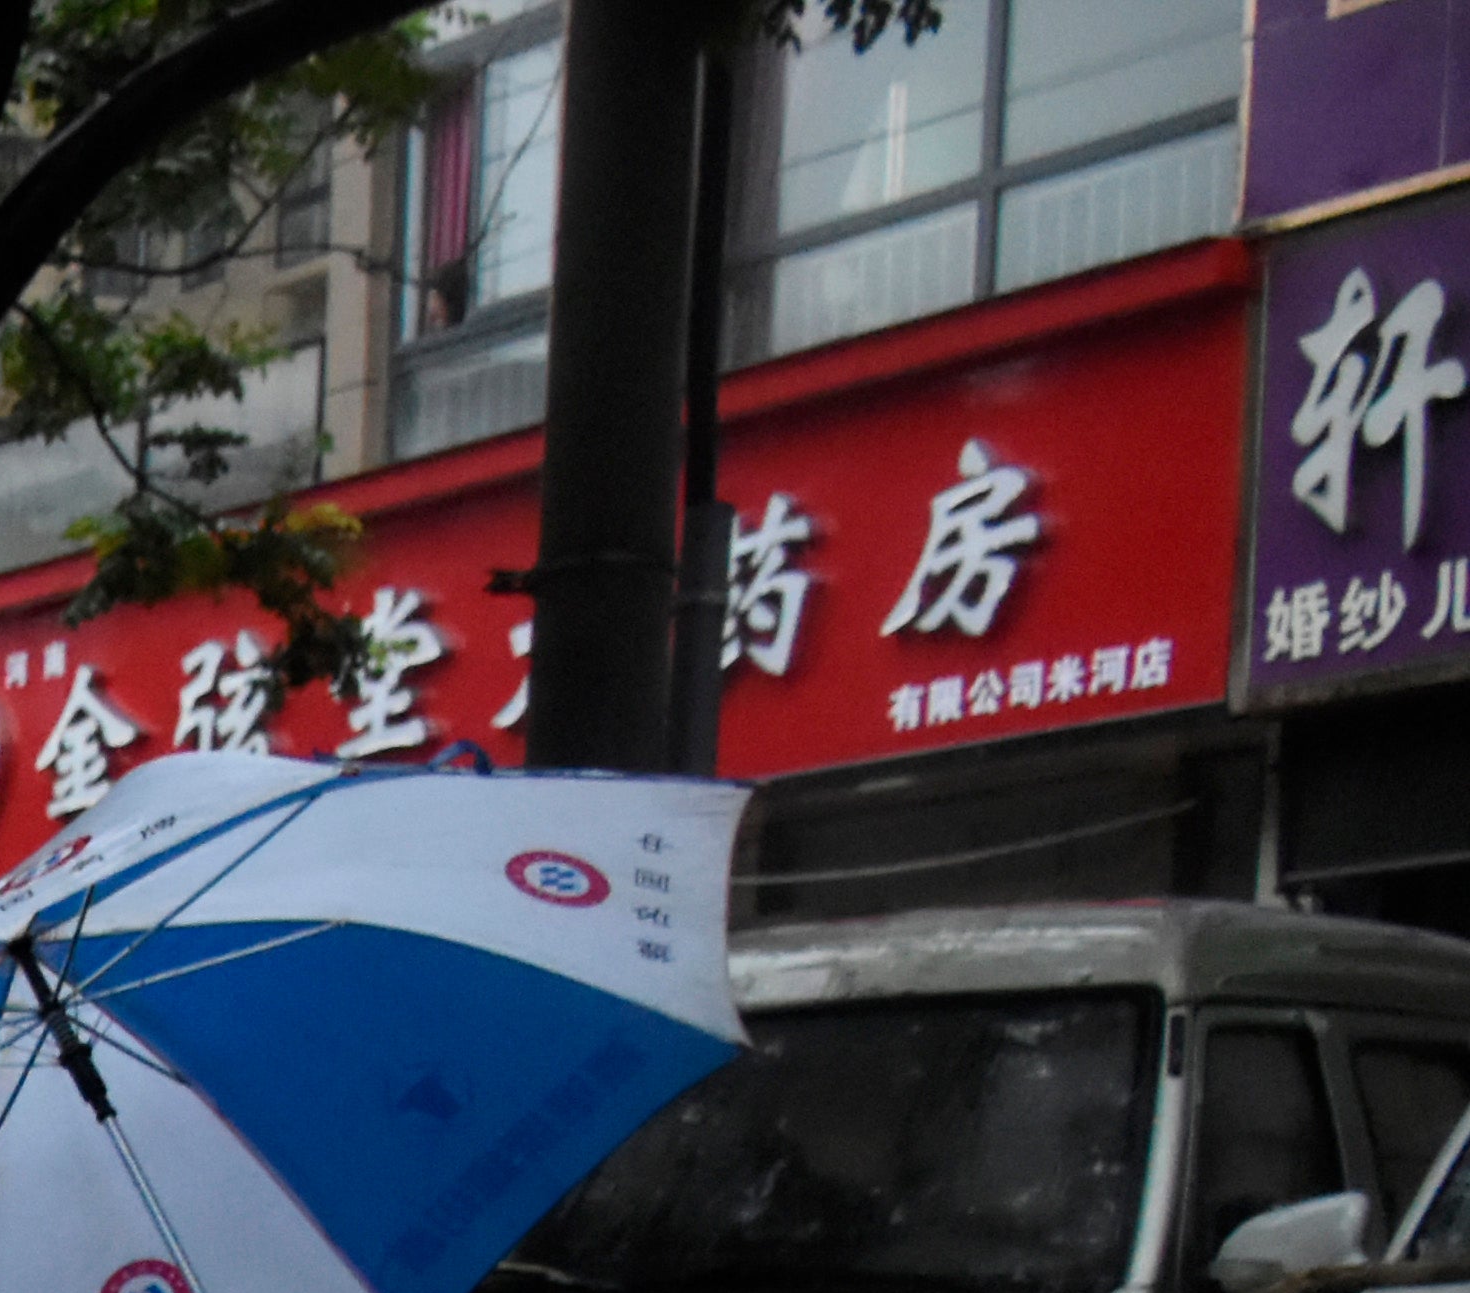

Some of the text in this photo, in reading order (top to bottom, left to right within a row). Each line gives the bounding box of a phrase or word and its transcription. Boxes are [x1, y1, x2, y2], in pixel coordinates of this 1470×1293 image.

[1290, 266, 1467, 550] 轩
[887, 636, 1173, 732] 有限公司米河店
